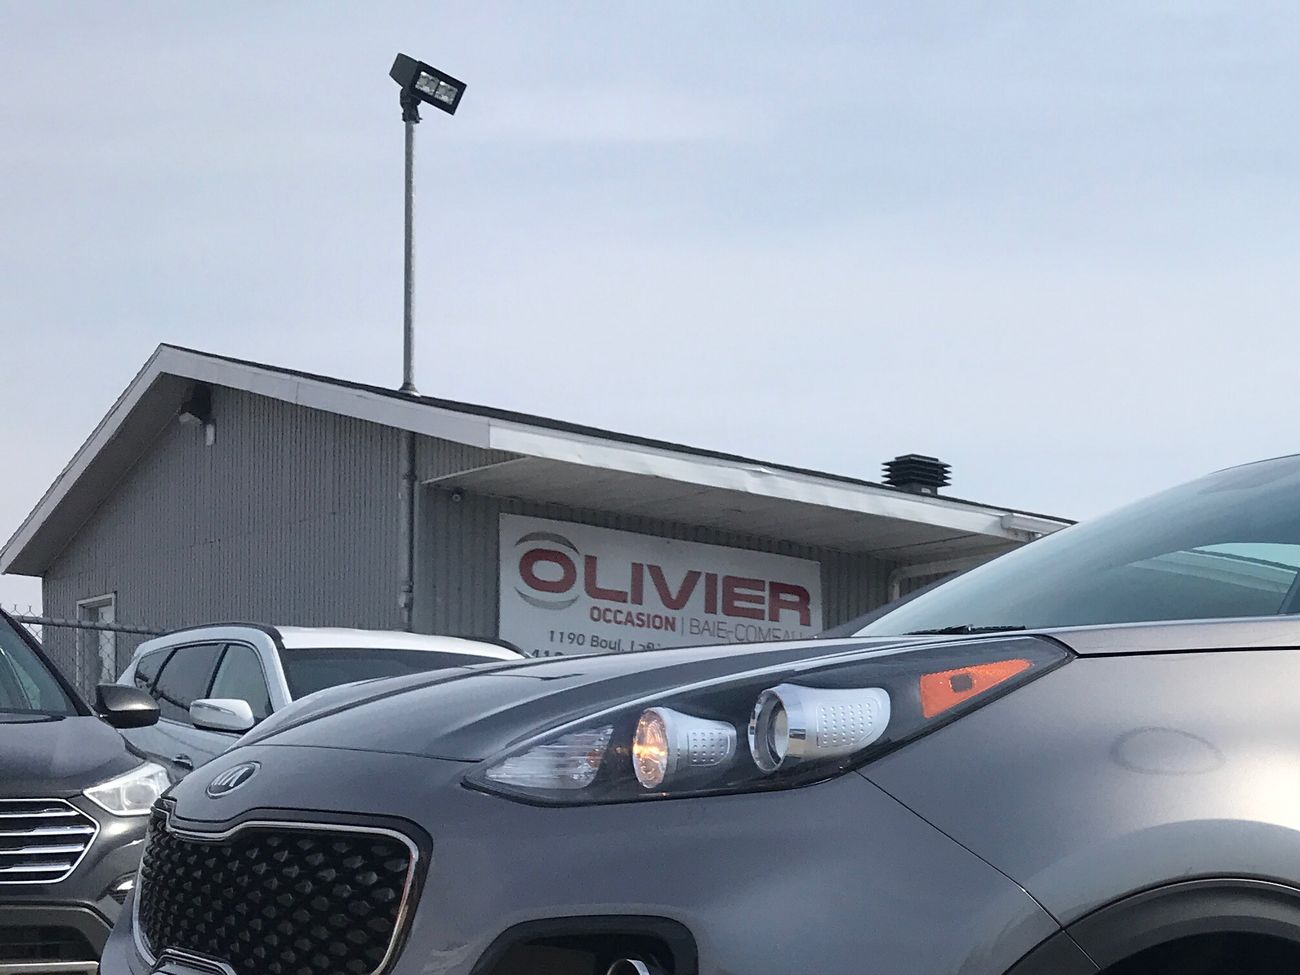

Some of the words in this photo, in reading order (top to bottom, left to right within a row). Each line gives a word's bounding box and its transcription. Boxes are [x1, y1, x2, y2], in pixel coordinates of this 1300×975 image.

[519, 548, 812, 627] OLIVIER
[589, 605, 677, 632] OCCASION
[549, 630, 586, 646] 1190
[590, 635, 626, 652] Boul.
